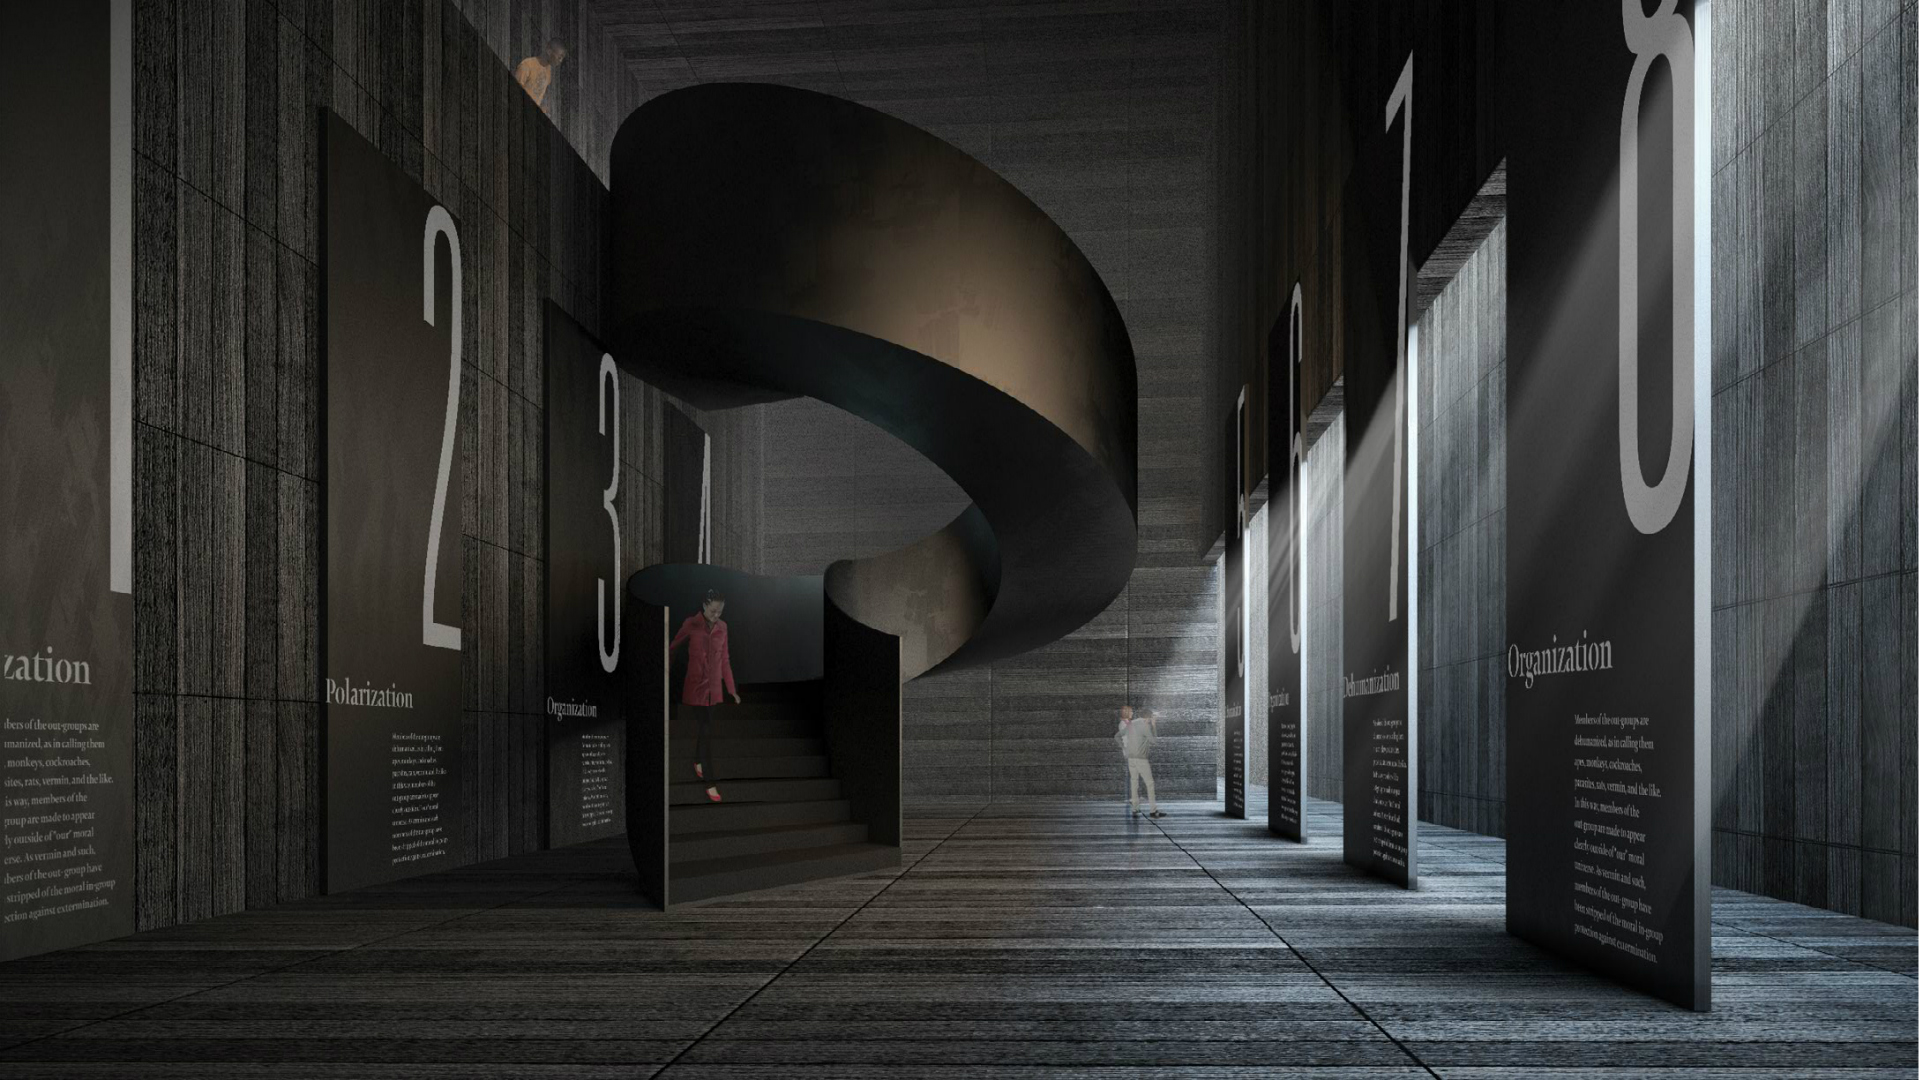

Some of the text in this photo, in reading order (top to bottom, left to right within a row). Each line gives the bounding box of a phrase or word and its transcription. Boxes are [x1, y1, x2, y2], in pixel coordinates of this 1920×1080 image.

[1621, 0, 1695, 534] 8
[1386, 49, 1413, 622] 7
[423, 205, 461, 651] 2
[1289, 281, 1302, 654] 6
[598, 353, 620, 672] 3
[1508, 629, 1613, 689] Organization
[326, 677, 413, 709] Polarization
[547, 696, 597, 722] Organization
[24, 719, 34, 729] of
[34, 719, 47, 730] the
[1639, 717, 1650, 725] are
[53, 739, 60, 748] in
[61, 738, 86, 751] calling
[86, 738, 105, 748] them
[1613, 736, 1620, 747] in
[1619, 736, 1639, 752] calling
[1638, 736, 1654, 749] them
[24, 778, 41, 786] rats,
[71, 774, 85, 784] and
[86, 774, 99, 784] the
[99, 773, 114, 783] like.
[1627, 783, 1638, 794] and
[1638, 783, 1648, 795] the
[31, 794, 66, 804] members
[66, 793, 76, 802] of
[75, 792, 88, 802] the
[40, 812, 62, 823] made
[71, 812, 95, 823] appear
[1630, 805, 1640, 818] the
[13, 832, 43, 844] outside
[44, 830, 53, 841] of
[73, 827, 94, 838] moral
[1626, 831, 1646, 843] appear
[24, 853, 34, 862] As
[35, 849, 62, 860] vermin
[62, 847, 77, 857] and
[1628, 853, 1645, 865] moral
[24, 870, 34, 881] of
[34, 869, 47, 879] the
[86, 863, 103, 873] have
[1620, 872, 1631, 884] and
[6, 888, 40, 904] stripped
[41, 886, 51, 897] of
[50, 886, 63, 896] the
[63, 881, 85, 894] moral
[28, 906, 56, 920] against
[1621, 920, 1638, 932] moral
